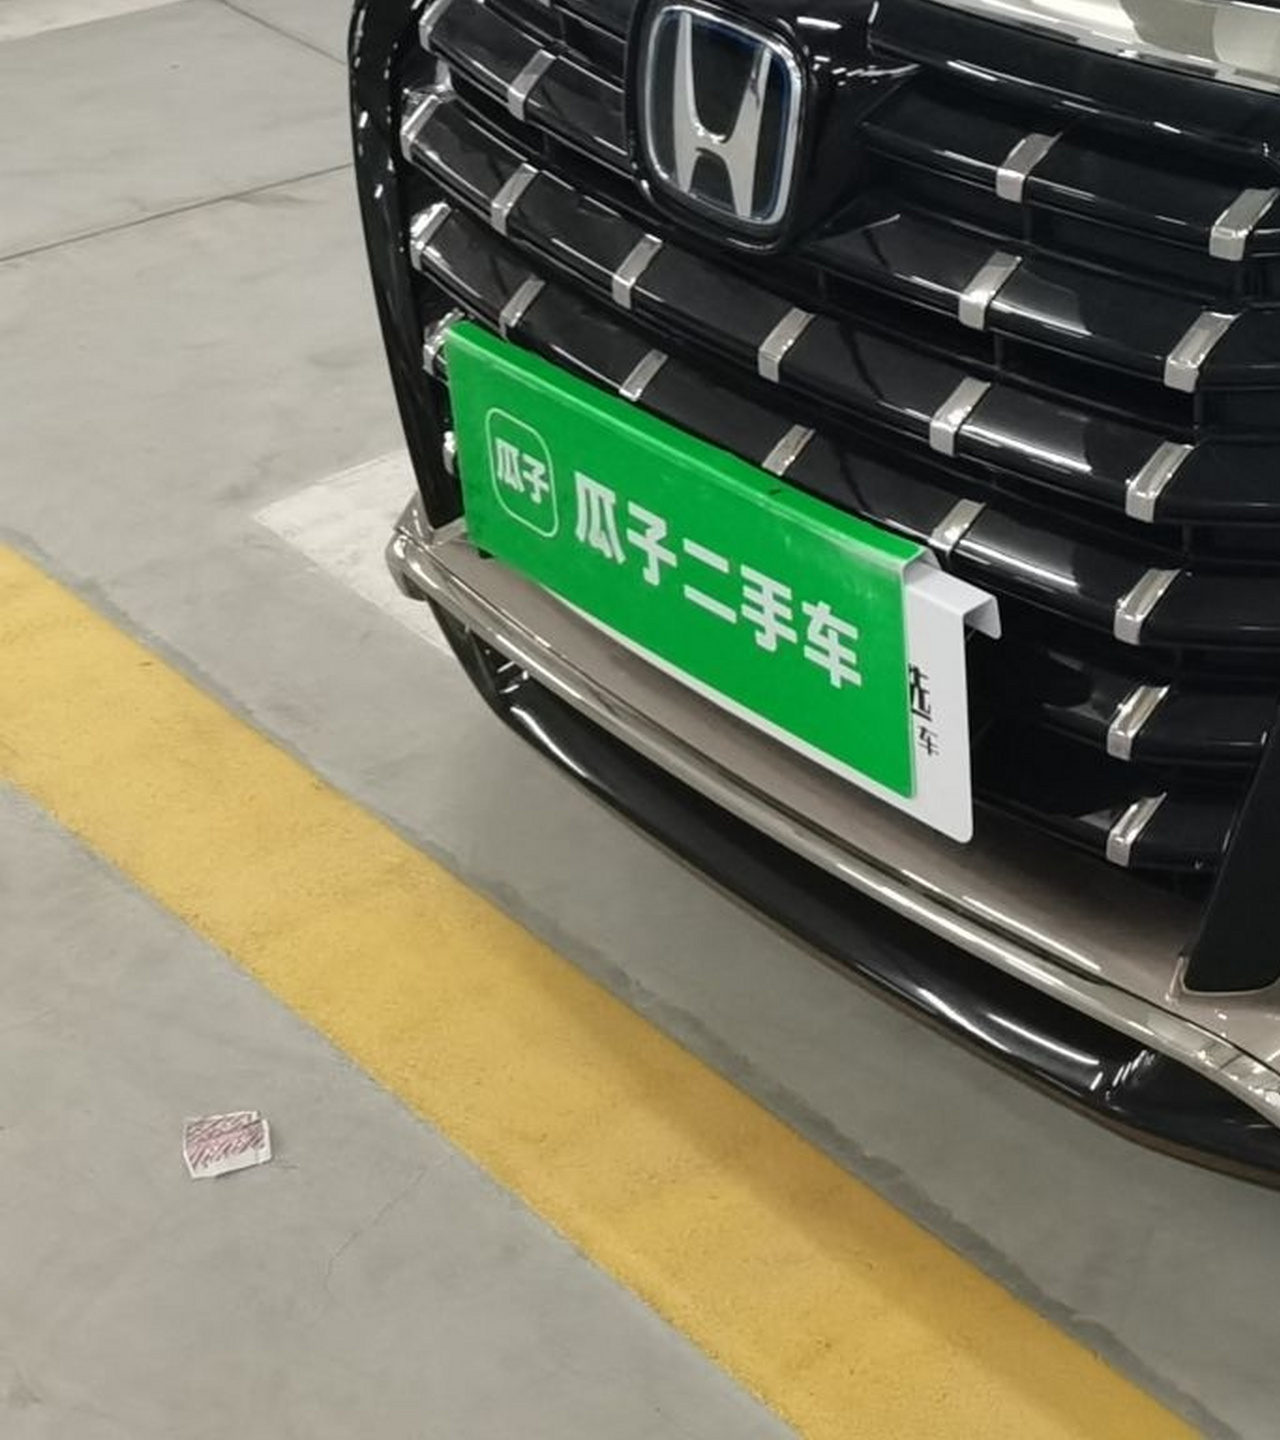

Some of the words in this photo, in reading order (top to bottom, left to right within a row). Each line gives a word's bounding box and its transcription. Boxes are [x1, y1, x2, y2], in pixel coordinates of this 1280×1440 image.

[493, 438, 551, 504] 瓜子
[574, 469, 862, 690] 瓜子二手车
